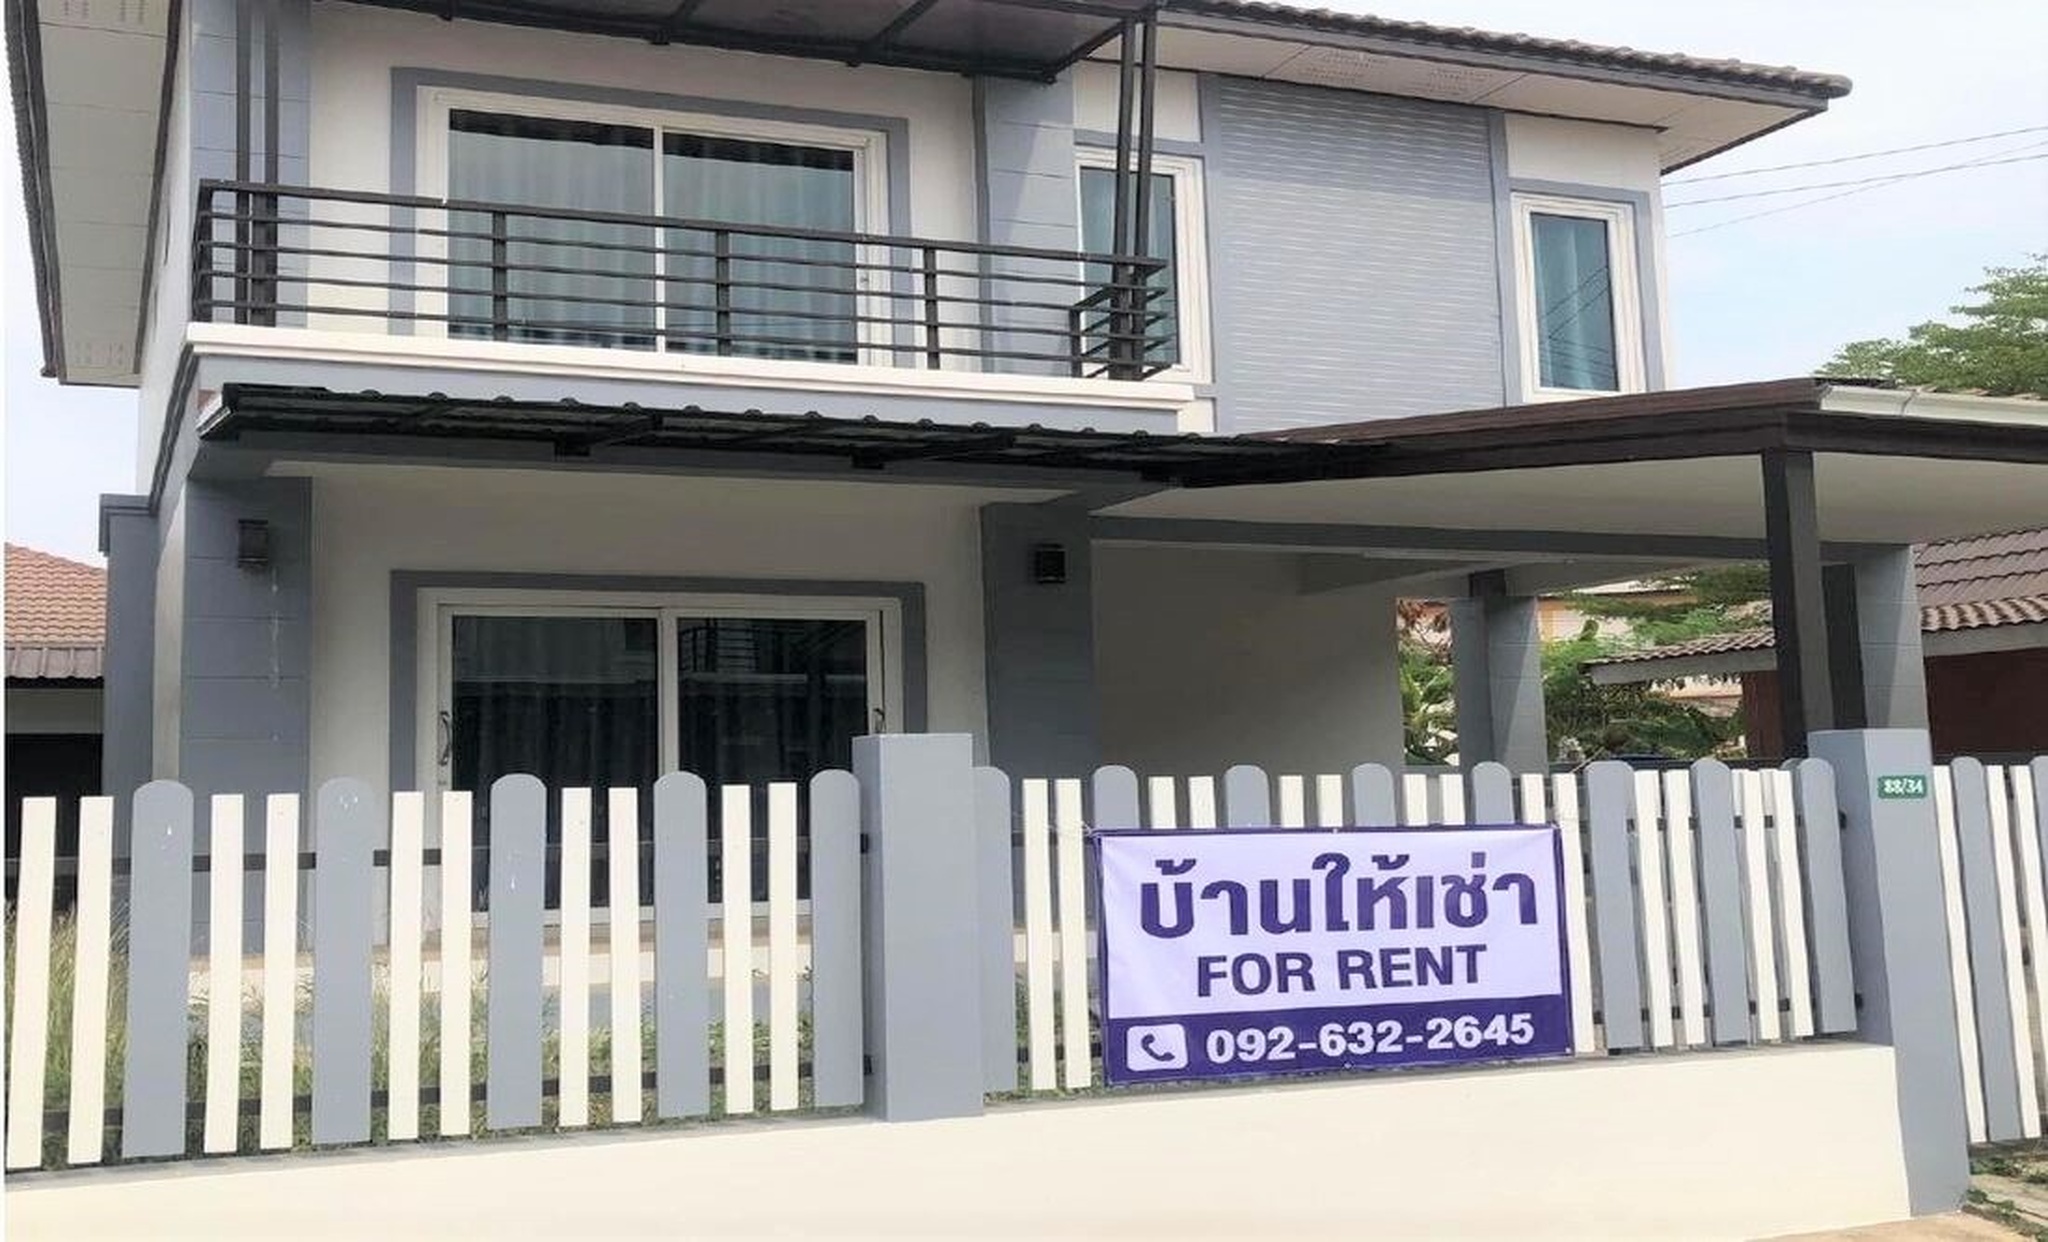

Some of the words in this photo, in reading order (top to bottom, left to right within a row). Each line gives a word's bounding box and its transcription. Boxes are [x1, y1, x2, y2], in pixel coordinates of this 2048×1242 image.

[1140, 851, 1538, 939] บ้านให้เช่า
[1197, 951, 1315, 997] FOR
[1337, 944, 1487, 990] RENT
[1206, 1013, 1534, 1064] 092-632-2645
